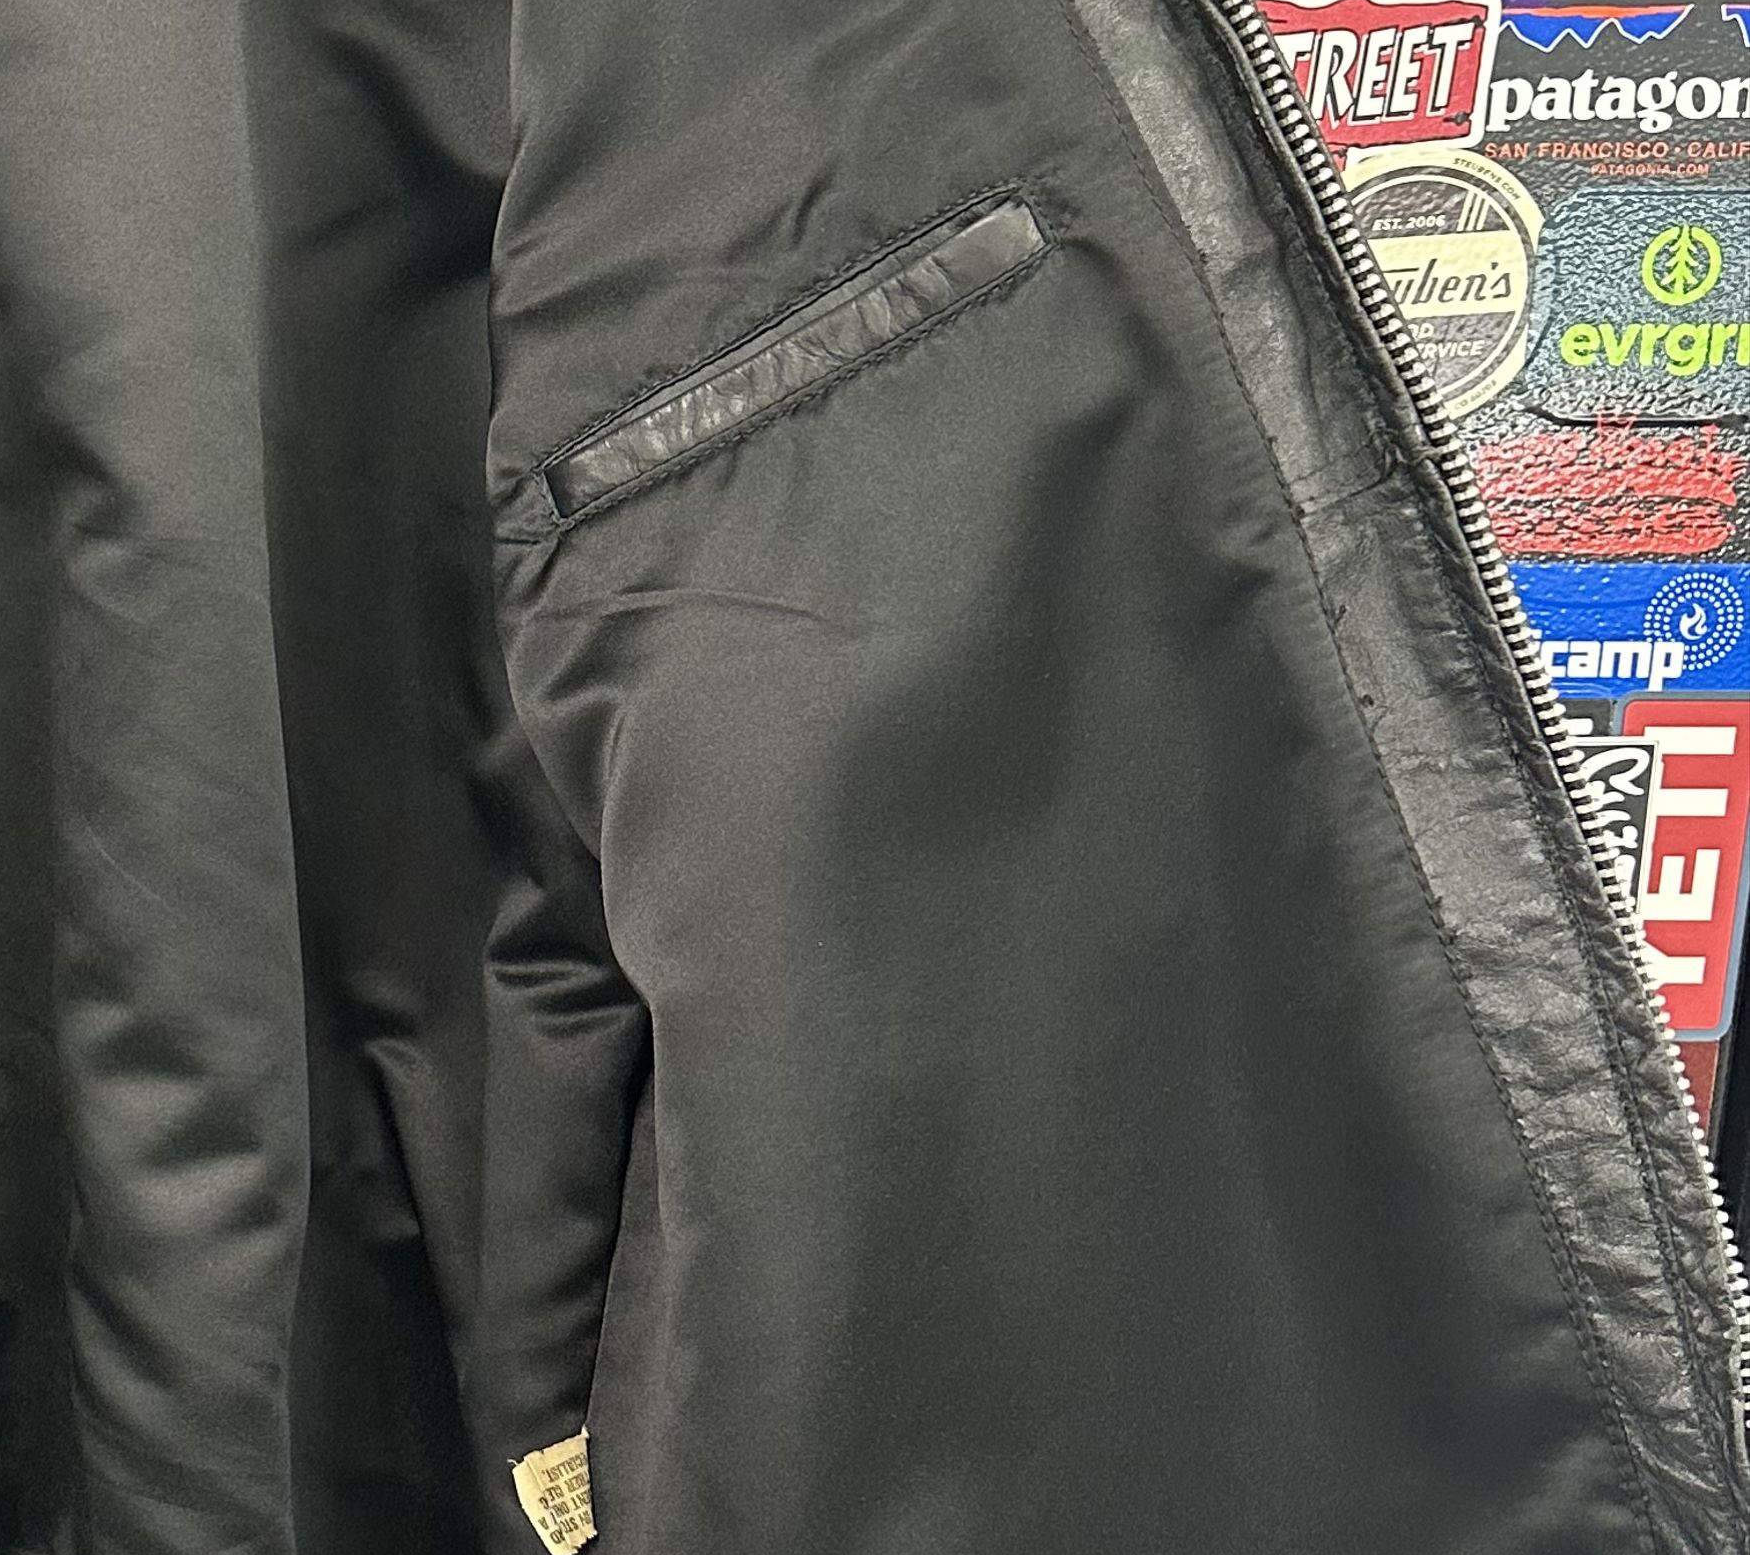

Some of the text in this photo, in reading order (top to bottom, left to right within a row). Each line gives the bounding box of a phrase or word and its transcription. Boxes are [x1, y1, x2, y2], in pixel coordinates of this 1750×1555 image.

[1486, 69, 1750, 134] patagon
[1485, 142, 1669, 158] SAN FRANCISCO
[1372, 215, 1446, 231] EST. 2006
